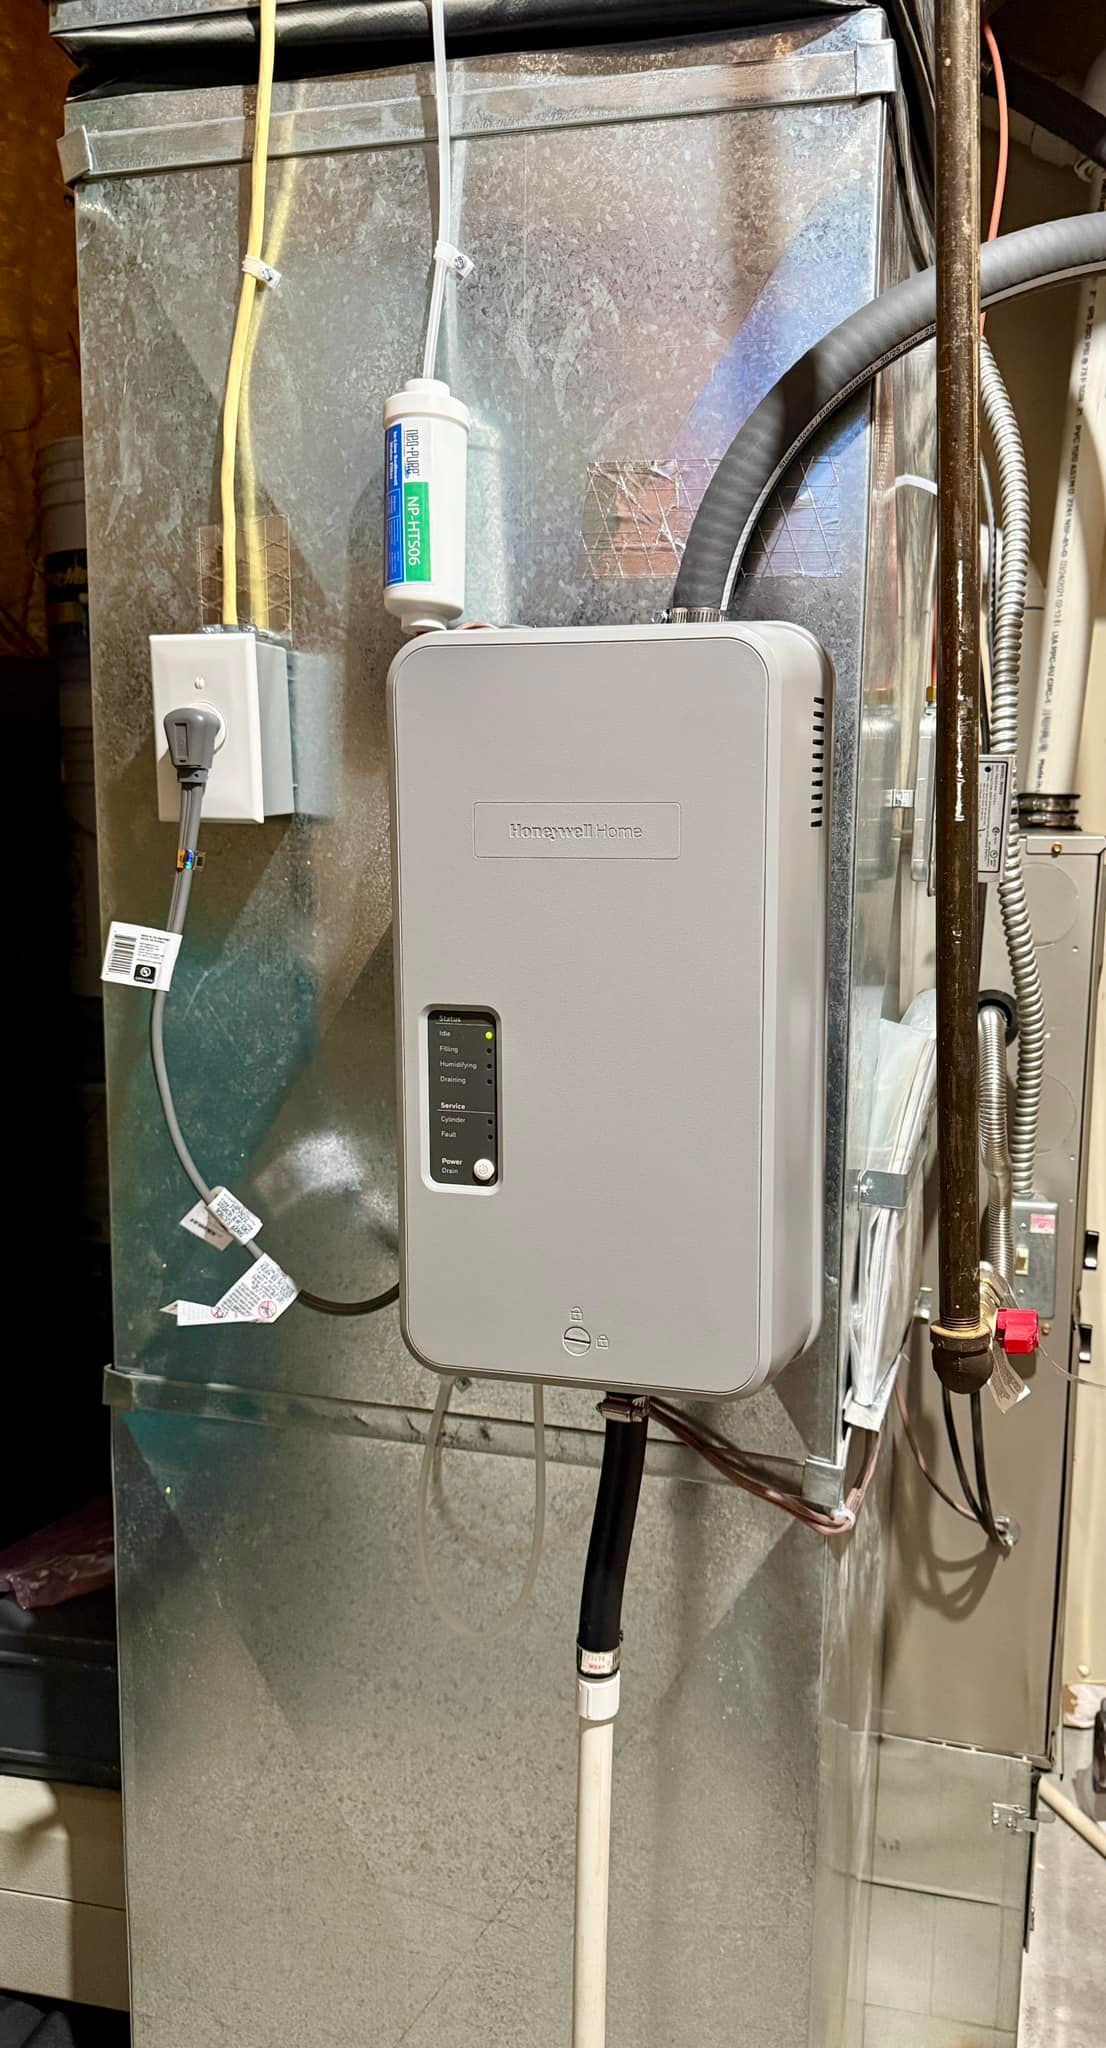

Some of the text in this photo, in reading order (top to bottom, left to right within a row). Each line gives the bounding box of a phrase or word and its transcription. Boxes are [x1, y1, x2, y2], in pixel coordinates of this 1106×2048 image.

[407, 496, 421, 566] NP-HTS06
[508, 823, 643, 840] Honeywell Home
[439, 1015, 462, 1023] Status
[439, 1045, 458, 1054] Filling
[439, 1075, 466, 1085] Draining
[440, 1101, 466, 1110] Service
[440, 1115, 466, 1124] Cylinder
[440, 1130, 457, 1138] Fault
[441, 1157, 463, 1166] Power
[441, 1166, 458, 1174] Drain
